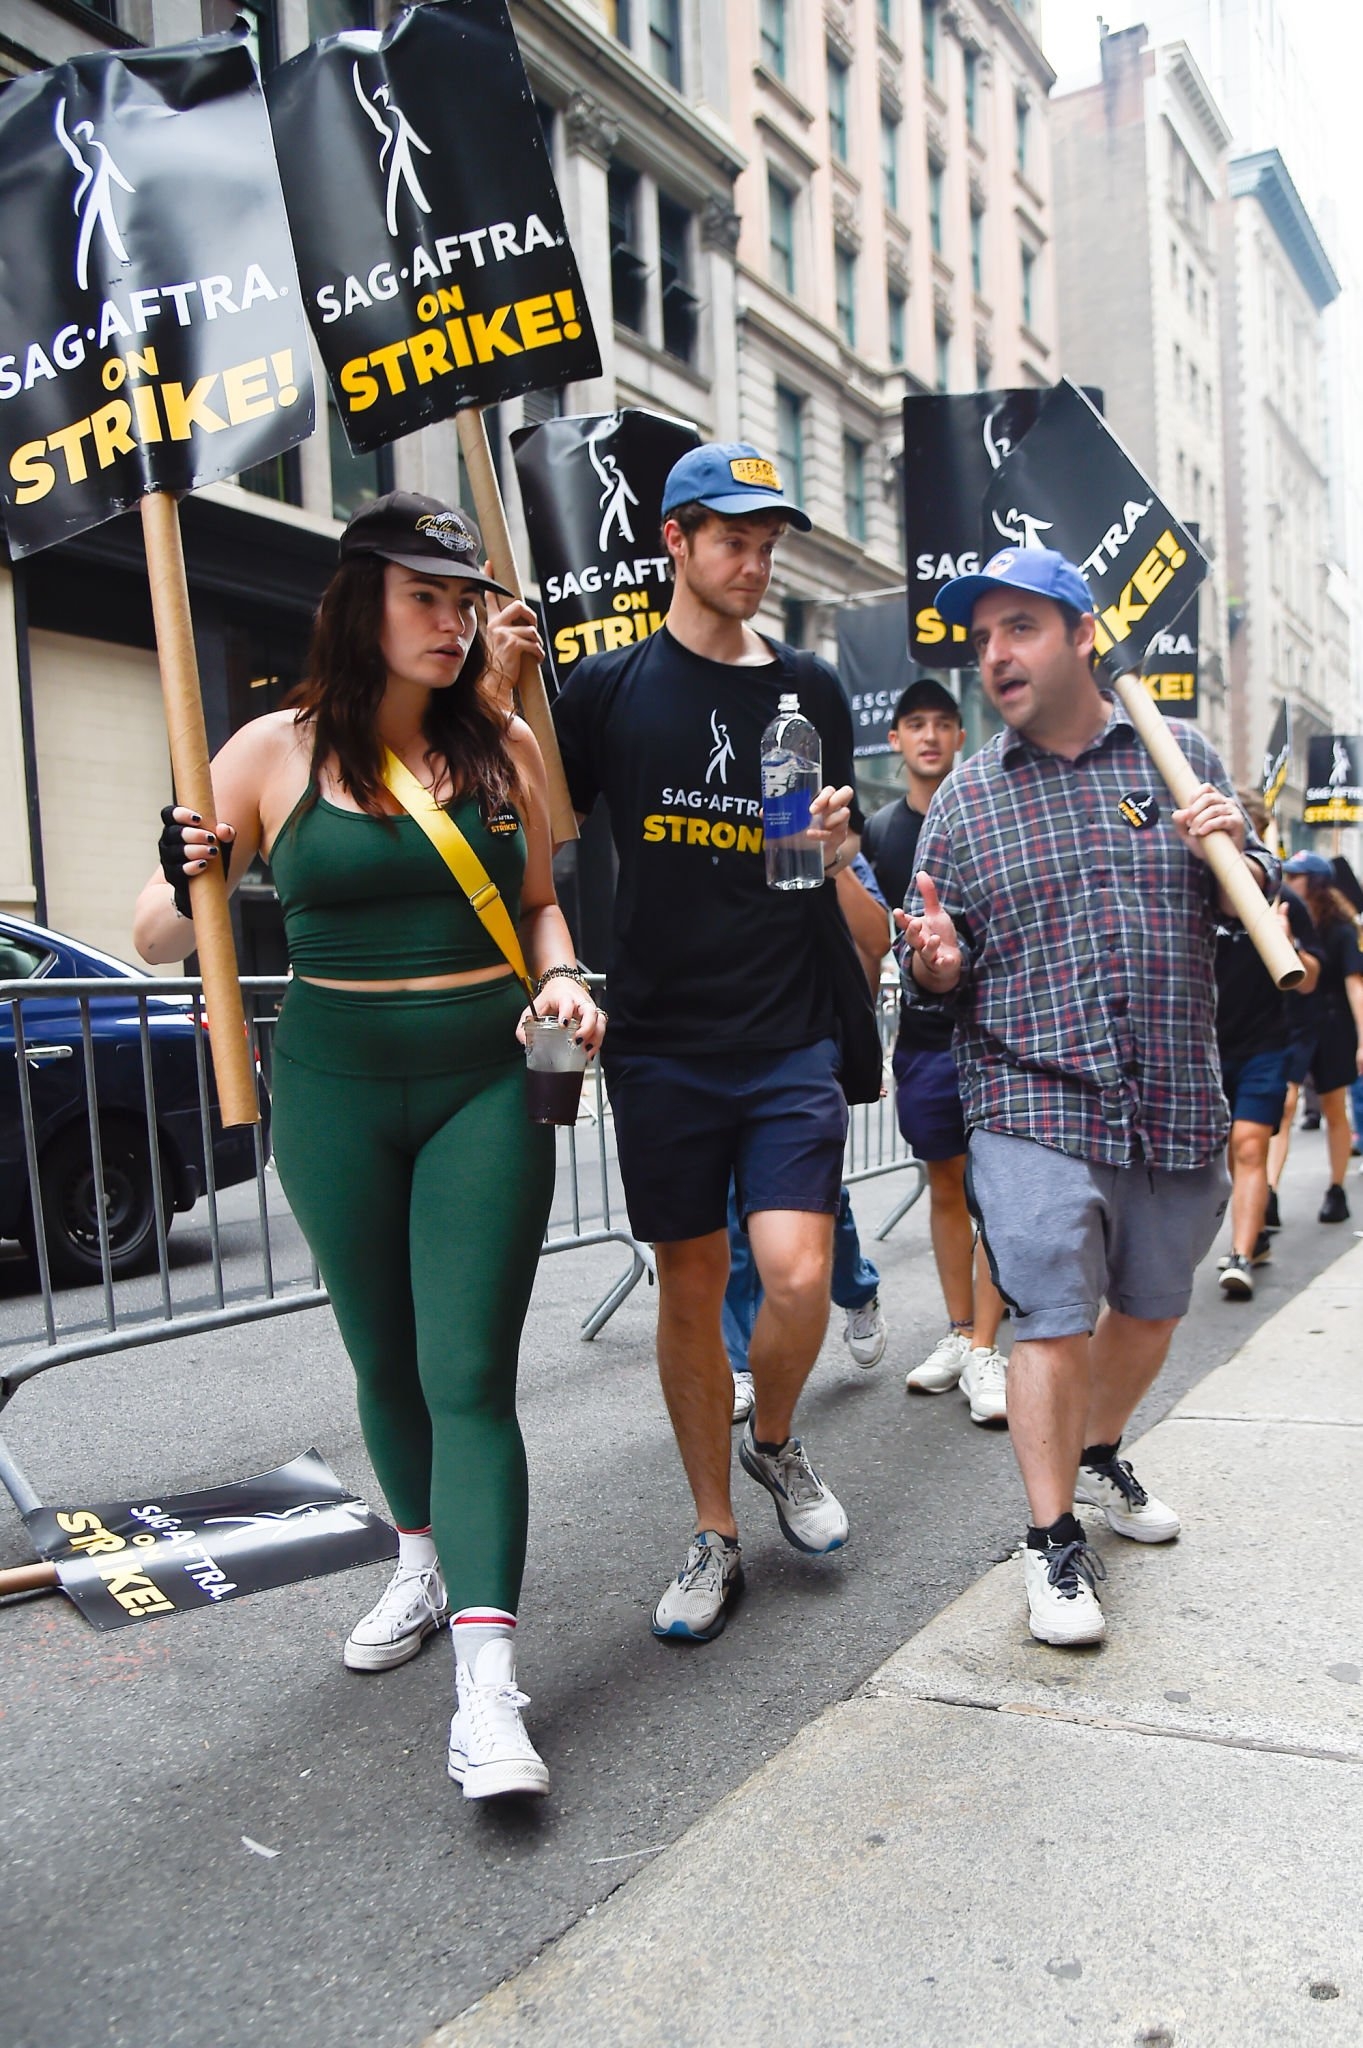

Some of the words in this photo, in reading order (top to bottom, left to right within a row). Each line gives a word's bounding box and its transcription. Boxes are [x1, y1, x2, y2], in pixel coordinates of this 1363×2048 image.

[416, 284, 465, 322] ON
[102, 346, 159, 391] ON
[340, 289, 582, 412] STRIKE!
[9, 349, 298, 505] STRIKE!
[612, 591, 649, 612] ON
[643, 814, 766, 854] STRON
[56, 1511, 176, 1617] STRIKE!
[132, 1534, 165, 1562] ON
